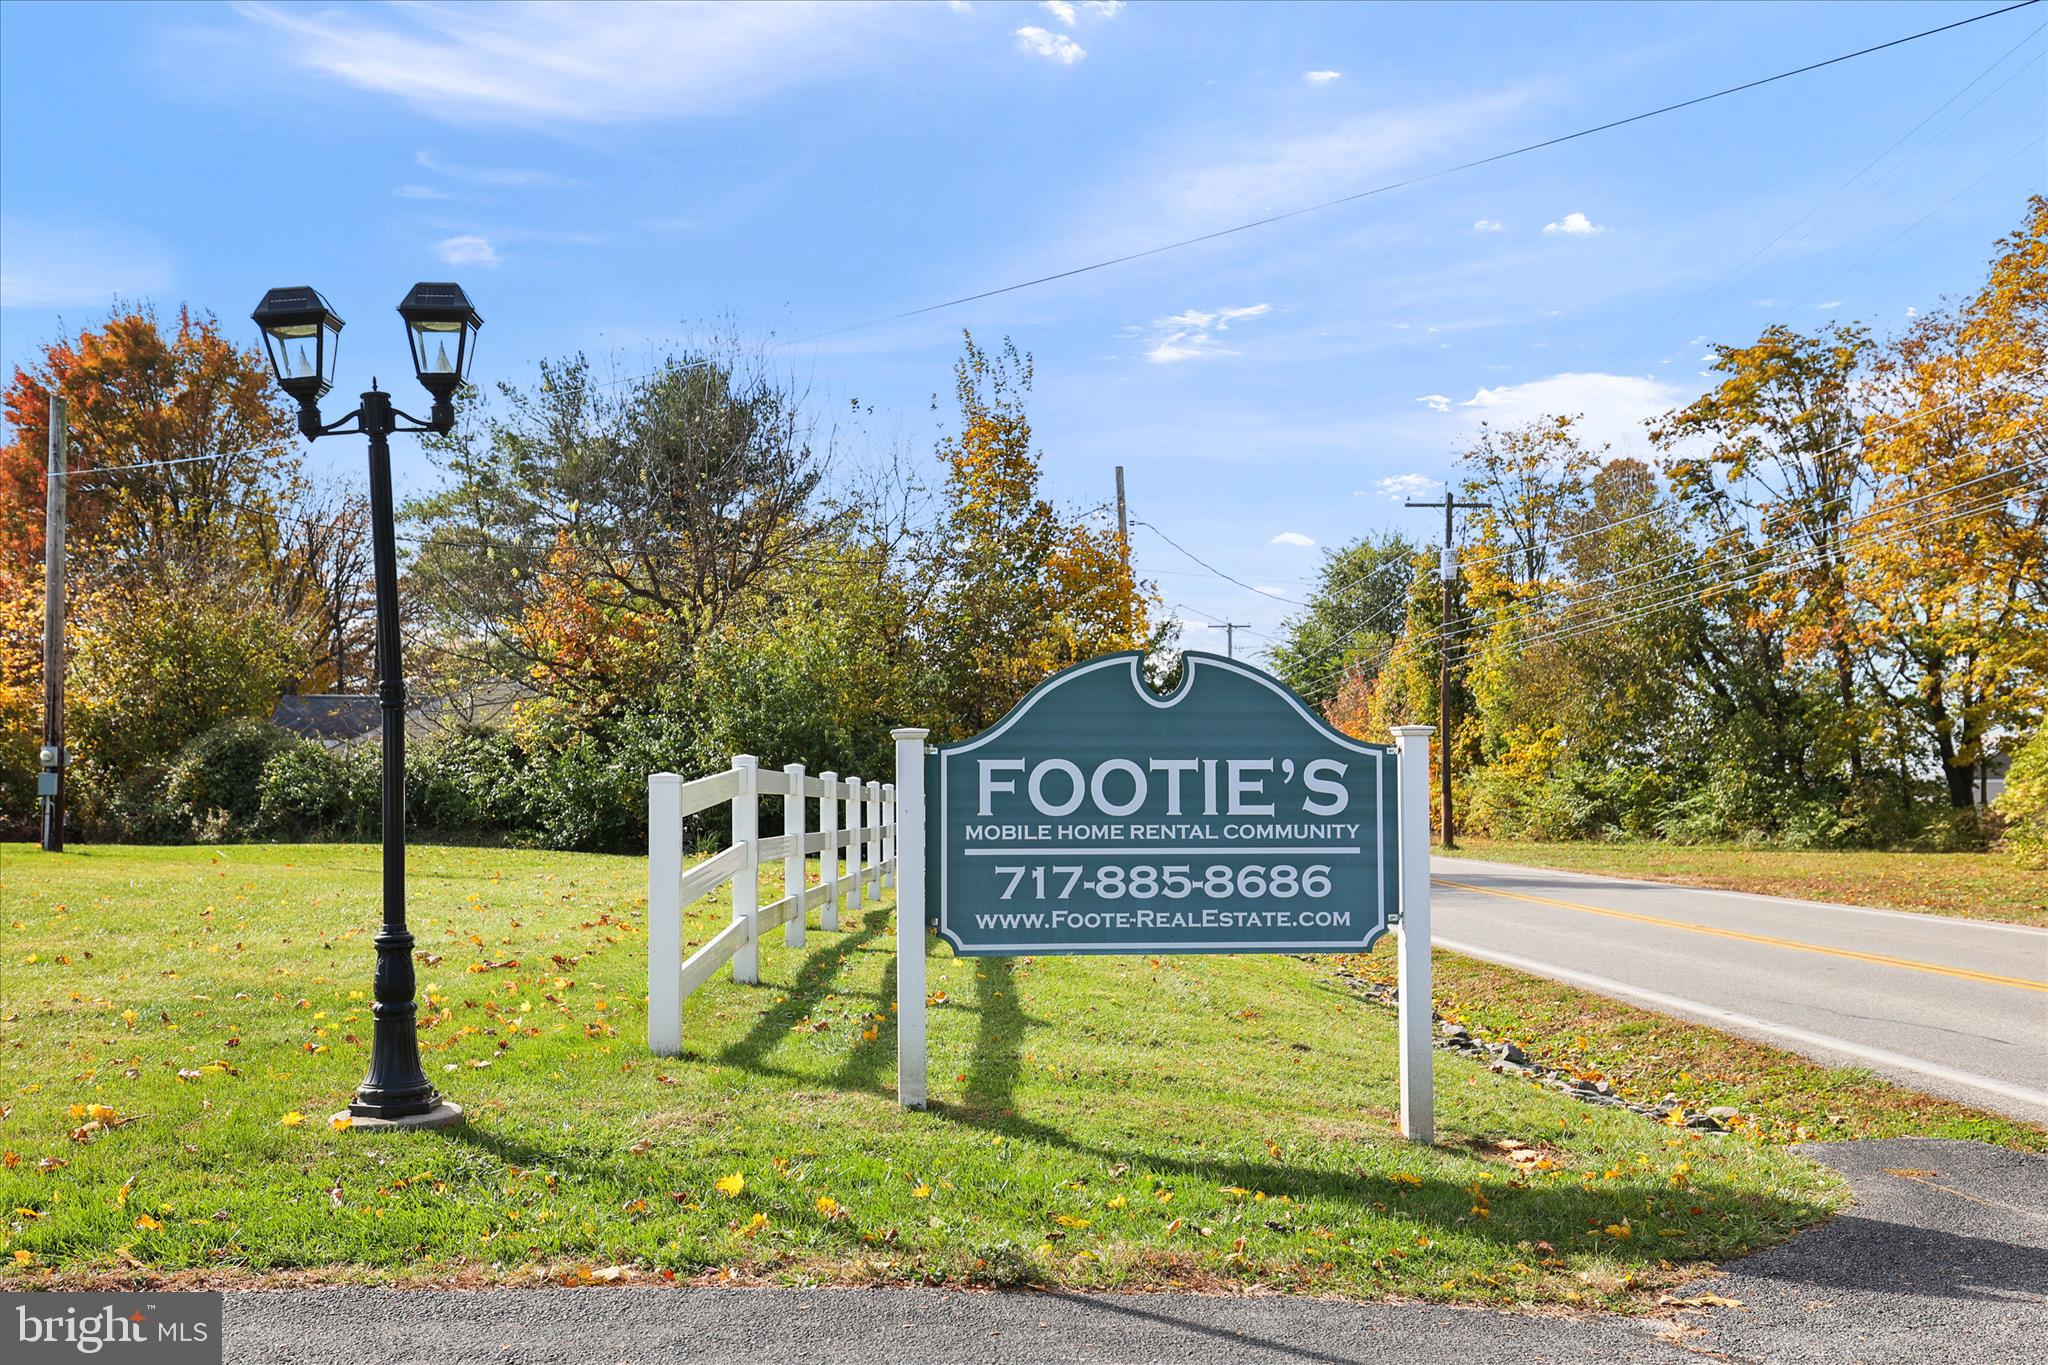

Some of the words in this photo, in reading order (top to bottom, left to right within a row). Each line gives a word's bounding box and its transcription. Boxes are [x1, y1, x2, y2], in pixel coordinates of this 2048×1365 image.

[976, 757, 1350, 818] FOOTIE'S
[966, 825, 1052, 840] MOBILE
[1058, 825, 1124, 840] HOME
[1130, 824, 1219, 840] RENTAL
[1224, 824, 1360, 840] COMMUNITY
[994, 864, 1332, 900] 717-885-8686
